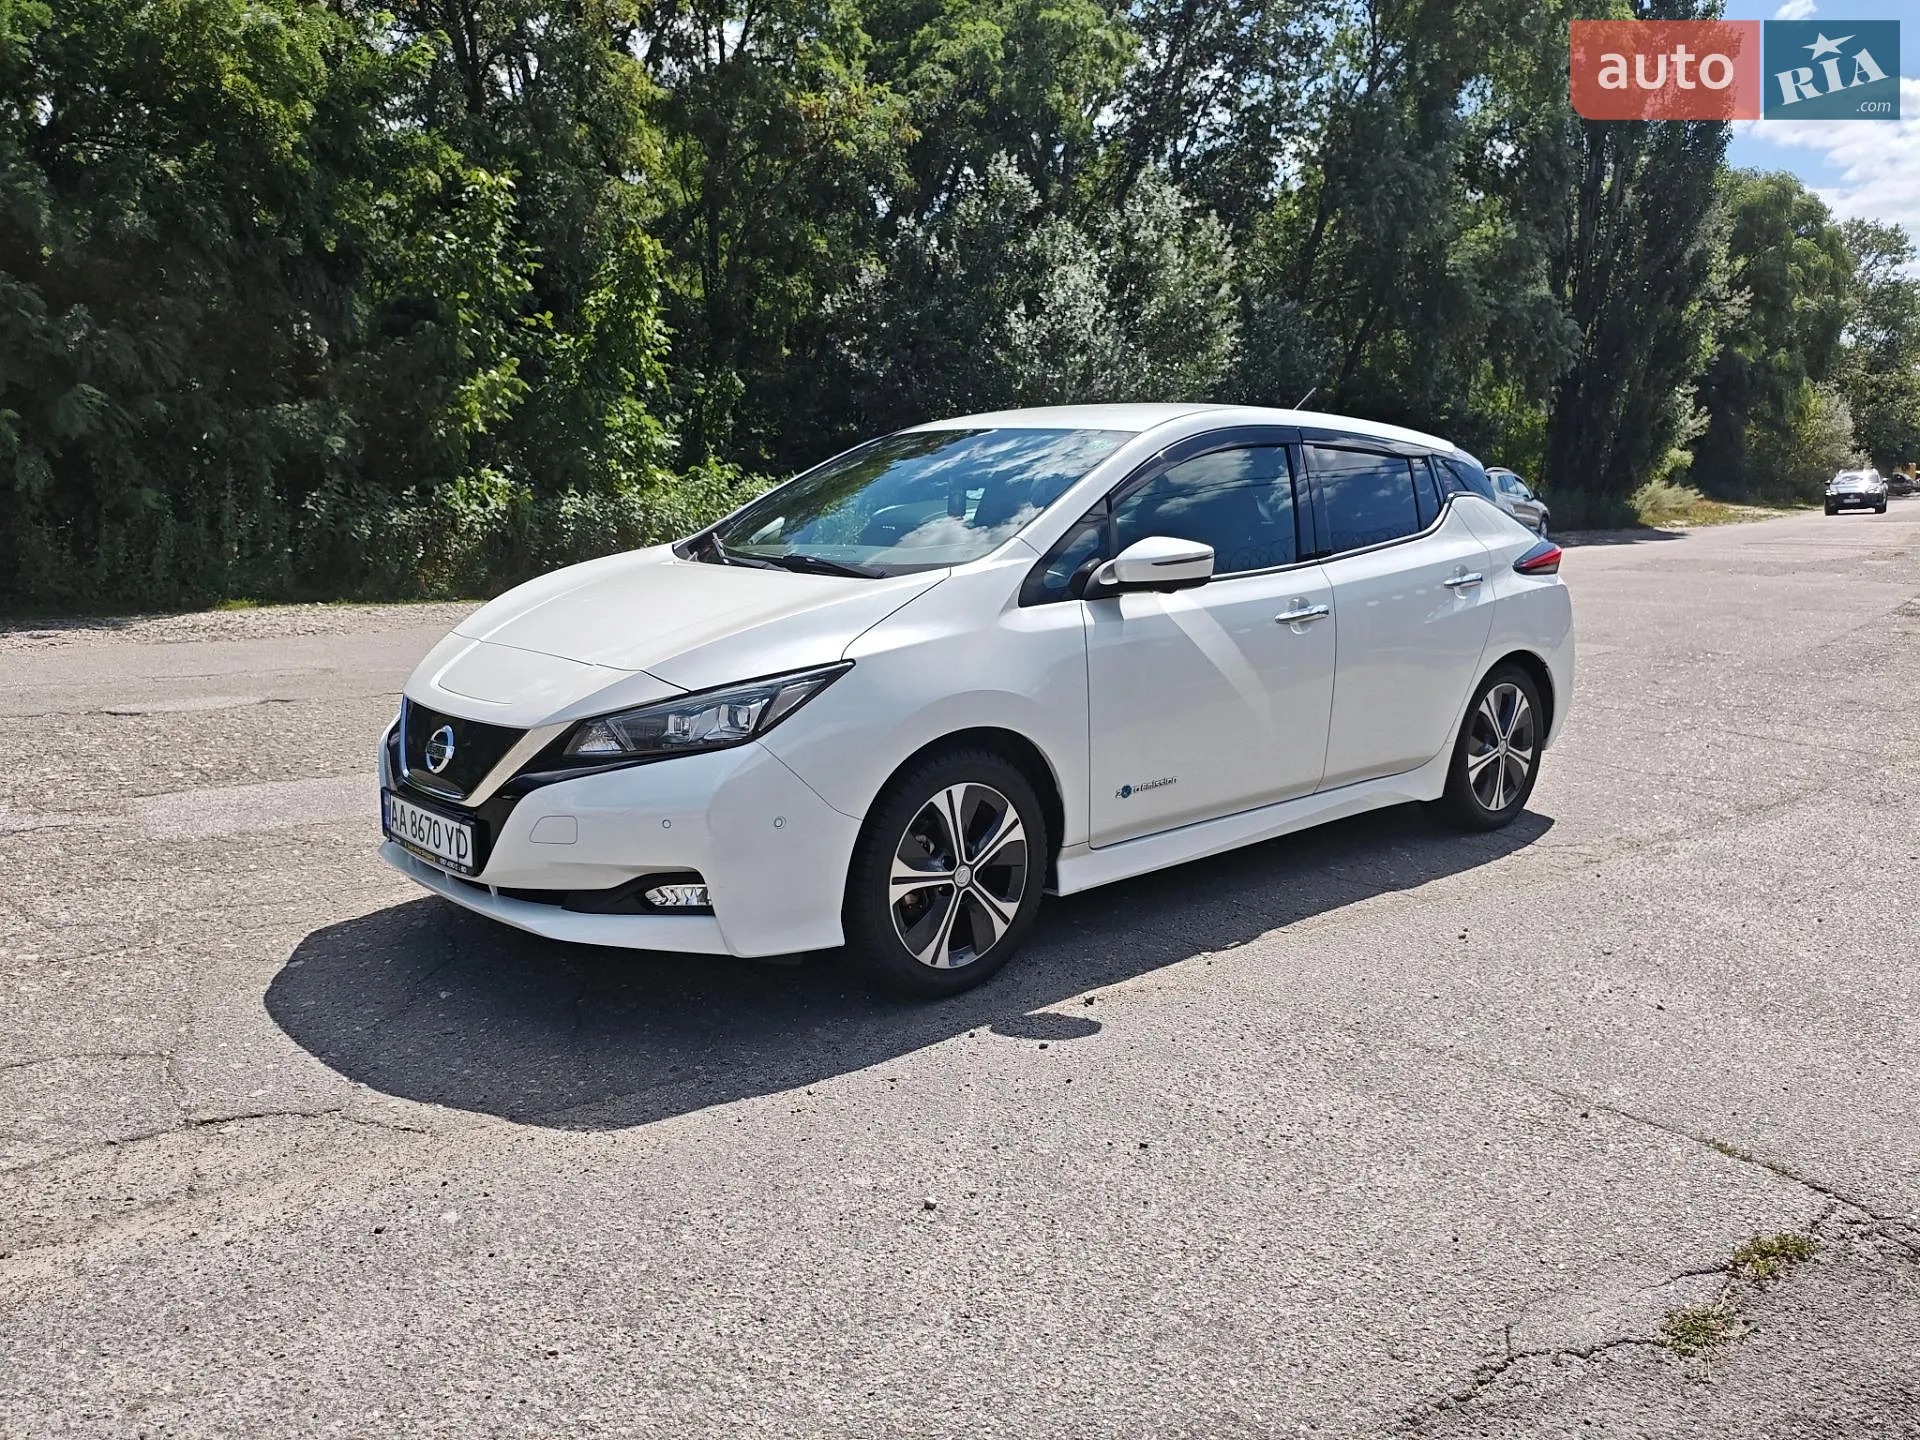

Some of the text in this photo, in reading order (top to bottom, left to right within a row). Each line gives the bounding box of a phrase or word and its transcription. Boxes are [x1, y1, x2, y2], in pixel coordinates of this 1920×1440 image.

[391, 801, 407, 834] AA
[410, 810, 441, 850] 8670
[445, 823, 468, 860] YD
